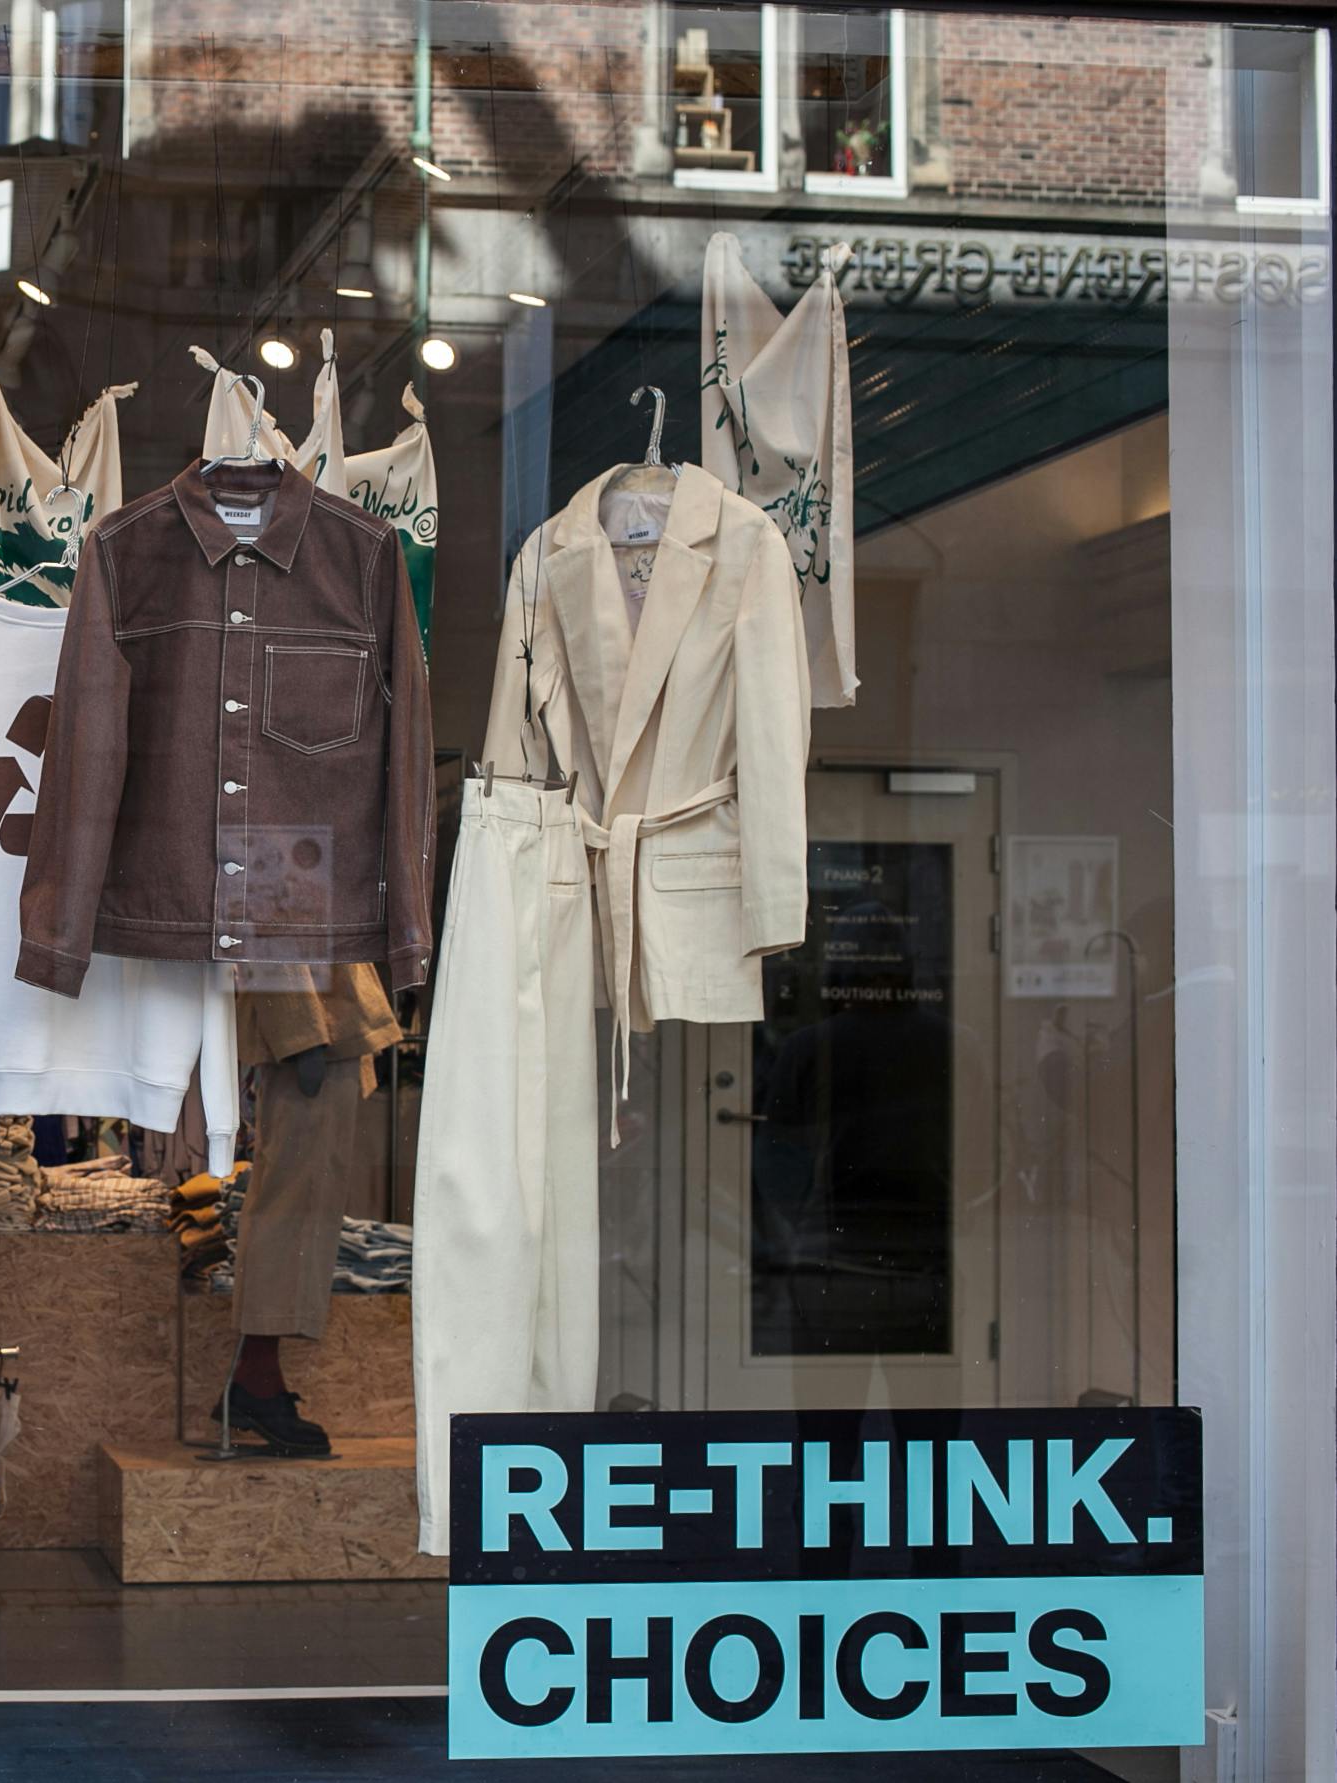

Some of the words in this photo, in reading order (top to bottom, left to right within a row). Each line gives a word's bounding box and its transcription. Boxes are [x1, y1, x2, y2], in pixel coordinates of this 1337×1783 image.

[224, 511, 252, 519] WEEKDAY
[820, 986, 892, 1001] BOUTIQUE
[896, 987, 944, 1002] LIVING
[482, 1439, 1172, 1551] RE-THINK.
[480, 1609, 1110, 1727] CHOICES
